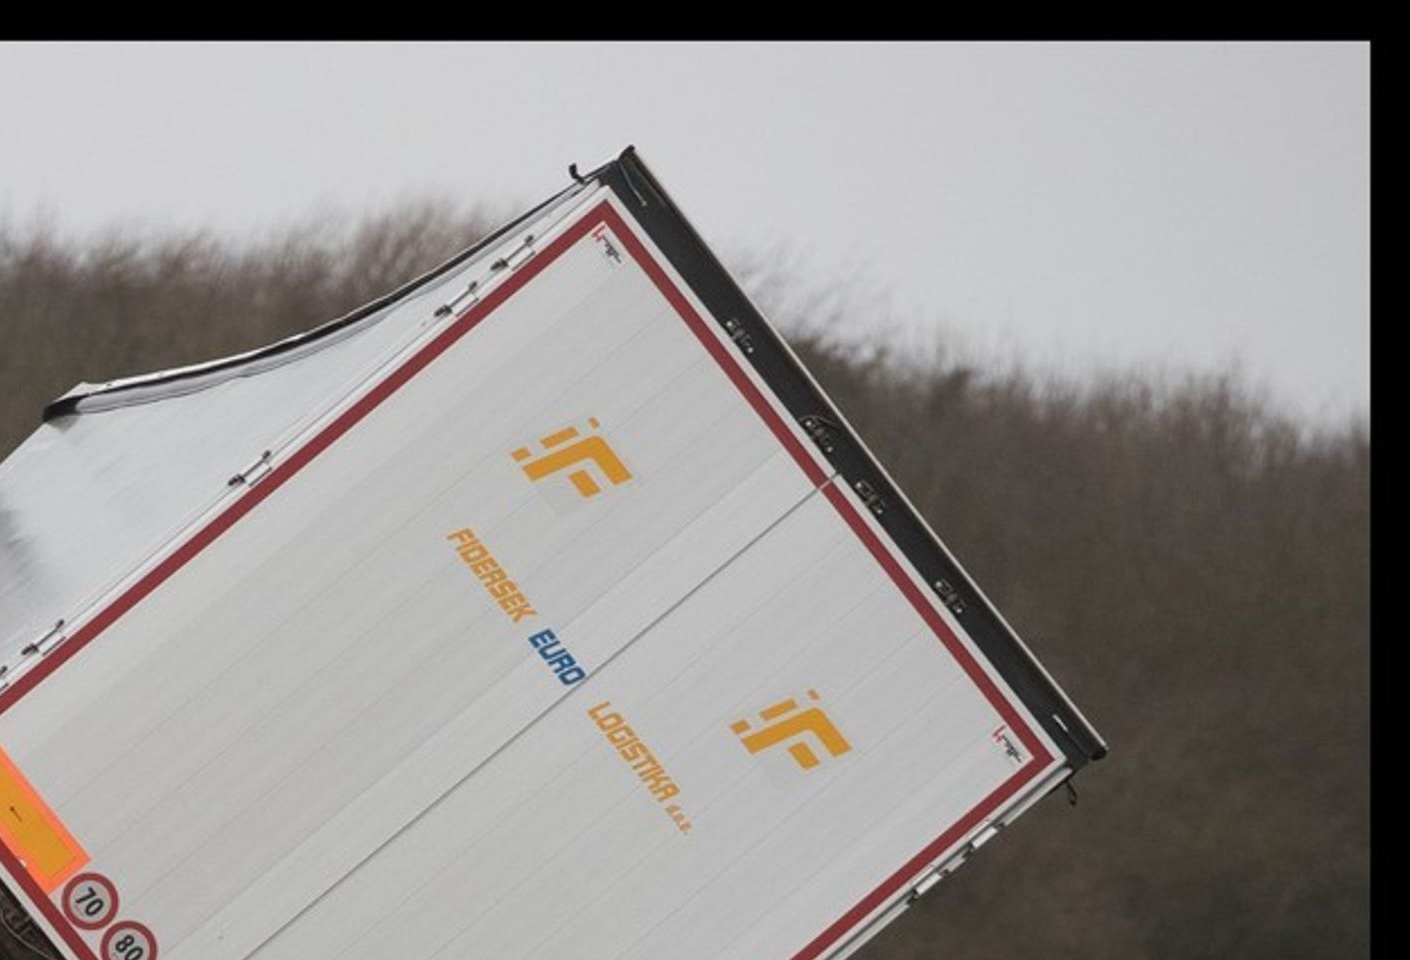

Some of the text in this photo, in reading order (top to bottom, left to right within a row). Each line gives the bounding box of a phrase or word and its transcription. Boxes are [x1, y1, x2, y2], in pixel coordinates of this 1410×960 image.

[528, 628, 587, 687] EURO
[587, 701, 681, 802] LOGISTIKA
[75, 887, 104, 916] 70
